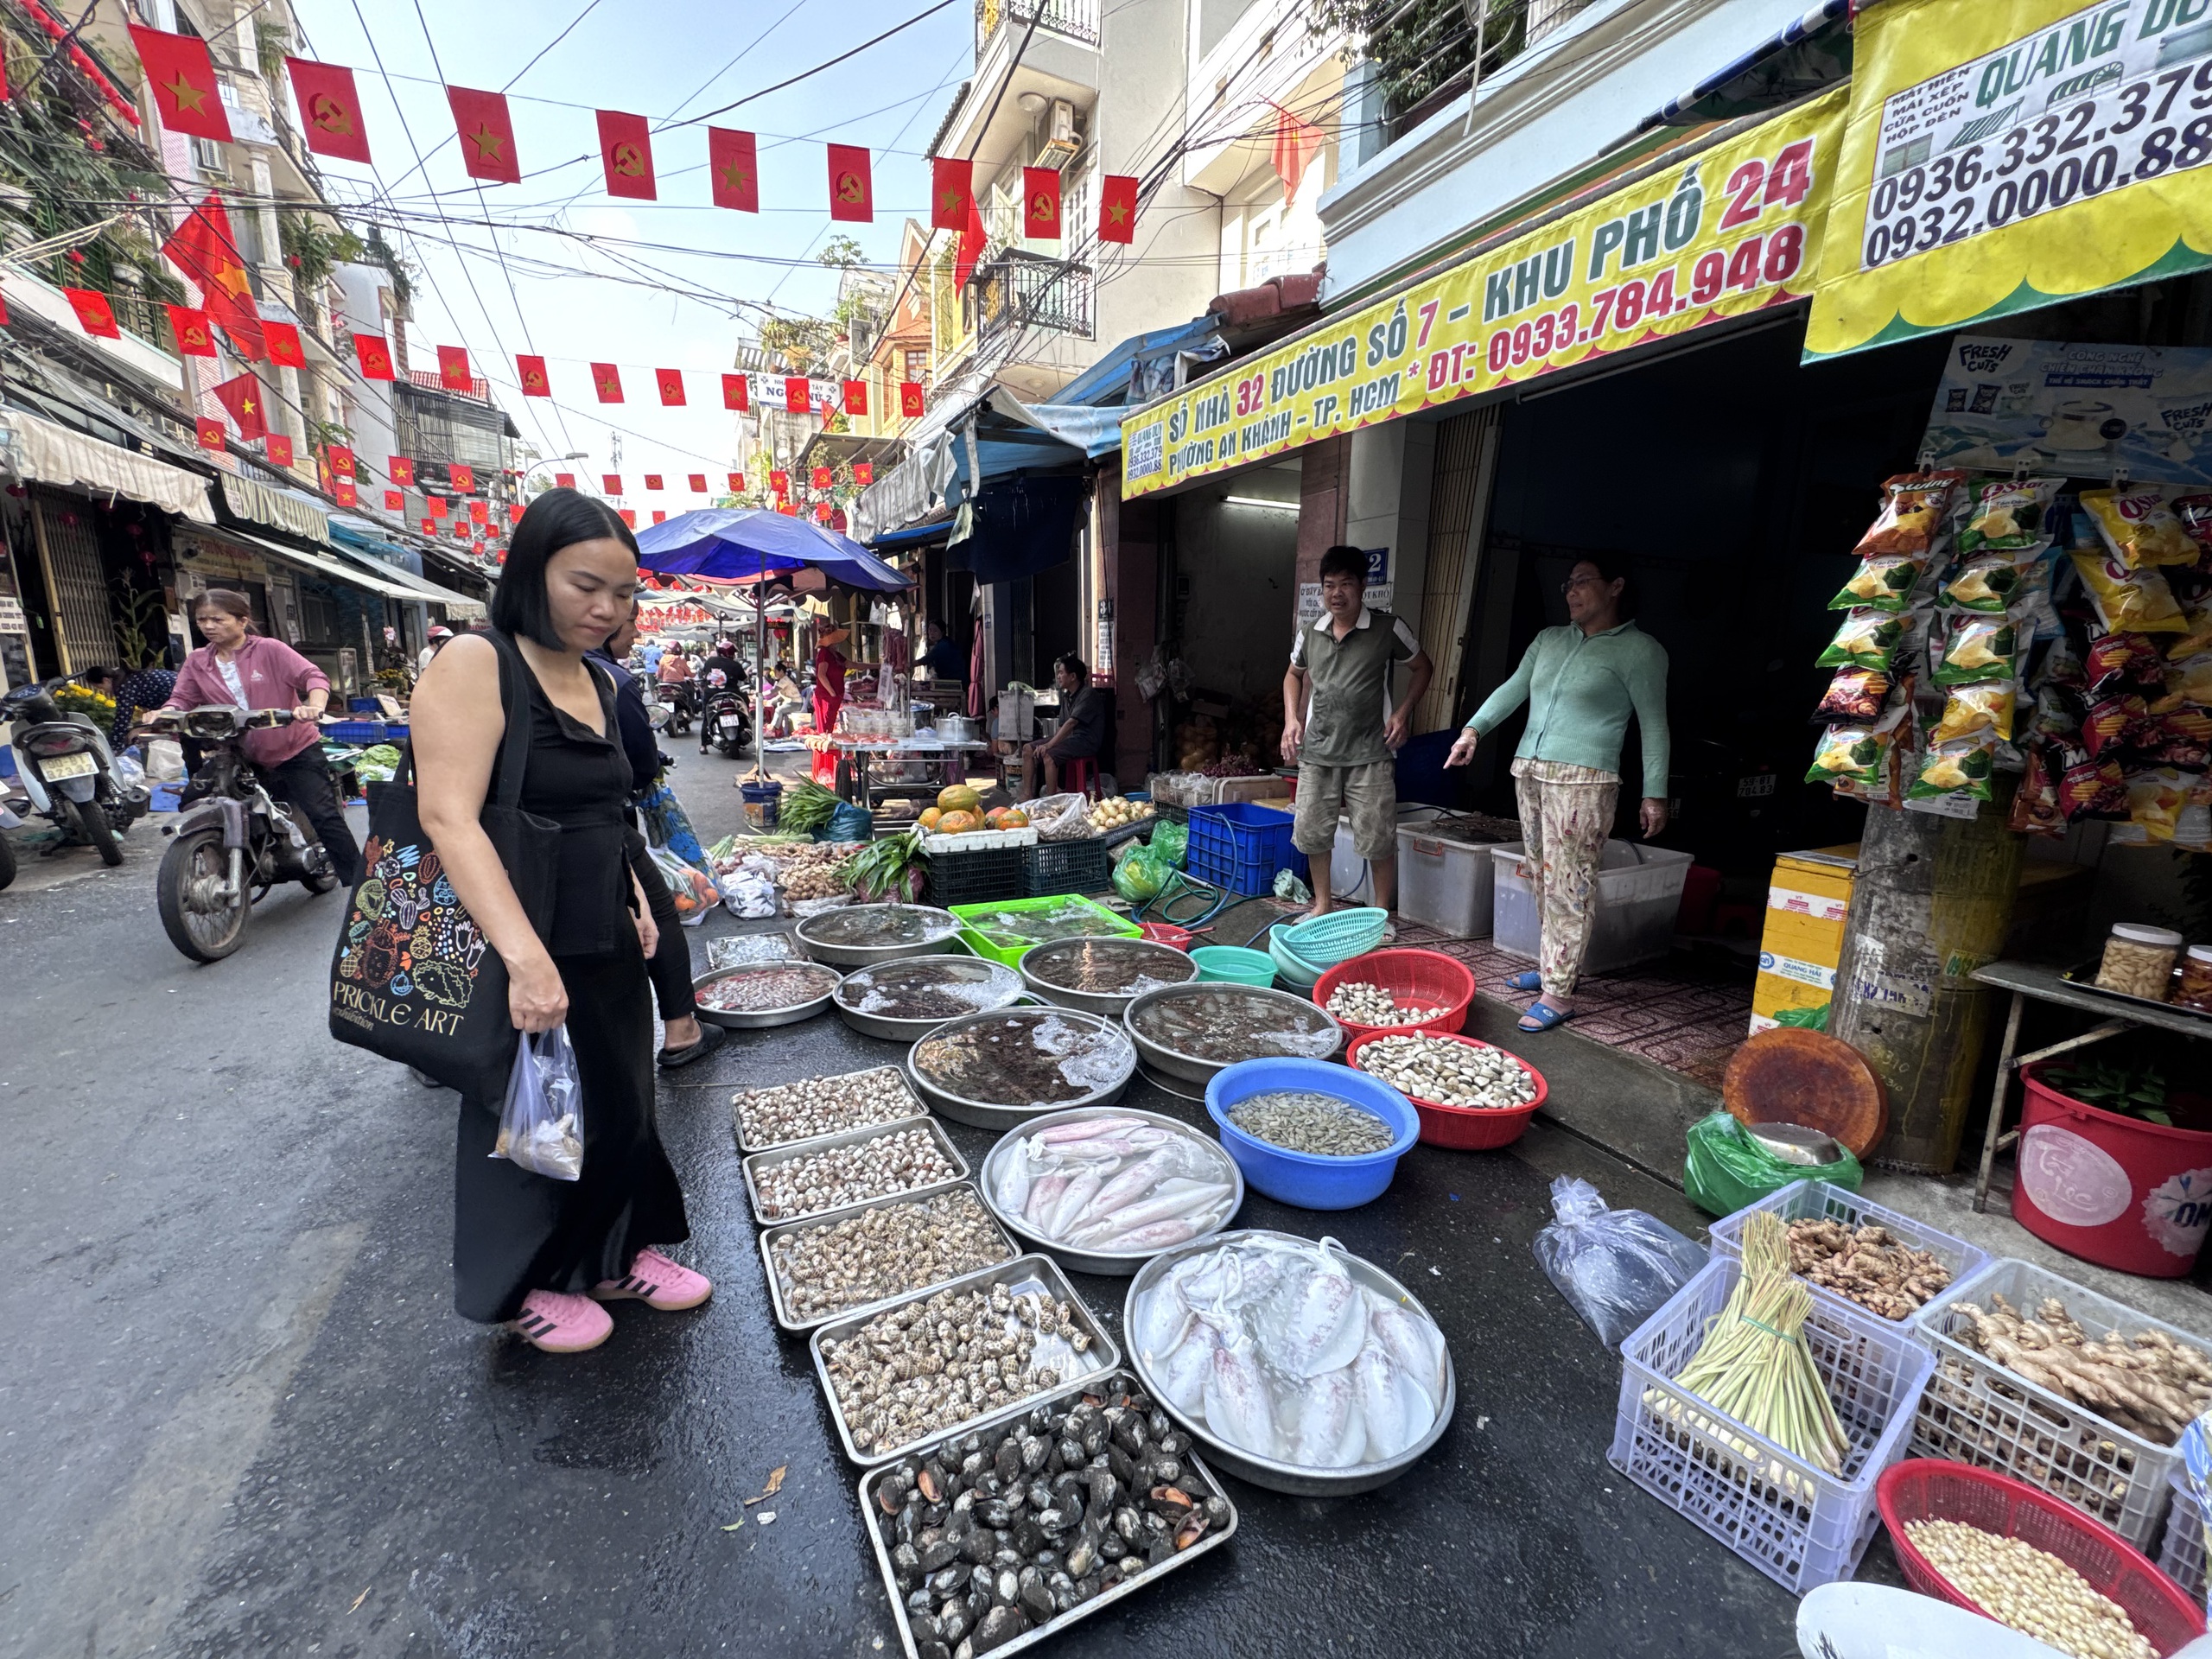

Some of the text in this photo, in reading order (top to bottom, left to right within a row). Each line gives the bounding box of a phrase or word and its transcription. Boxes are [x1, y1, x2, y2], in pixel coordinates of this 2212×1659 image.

[1976, 0, 2130, 109] QUANG
[1892, 82, 1964, 118] MÁI XẾP
[1922, 92, 1969, 117] CUỐN
[1169, 397, 1188, 443] SỐ
[1194, 385, 1230, 434] NHÀ
[1236, 374, 1265, 416] 32
[1271, 336, 1357, 404] ĐƯỜNG
[1367, 299, 1408, 367] SỐ
[1418, 301, 1439, 349] 7
[1484, 240, 1574, 323] KHU
[1589, 162, 1703, 280] PHỐ
[1719, 139, 1814, 231] 24
[1169, 439, 1213, 475] PHƯỜNG
[1218, 430, 1236, 460] AN
[1242, 410, 1292, 453] KHÁNH
[1313, 397, 1341, 428] TP.
[1349, 372, 1401, 417] HCM
[1428, 345, 1478, 391] ĐT:
[1488, 225, 1803, 372] 0933.784.948
[1959, 344, 2013, 366] FRESH
[1967, 359, 1999, 373] CUTS
[1783, 963, 1808, 973] QUANG
[333, 1007, 375, 1032] exhibition
[334, 982, 464, 1036] PRICKLE ART
